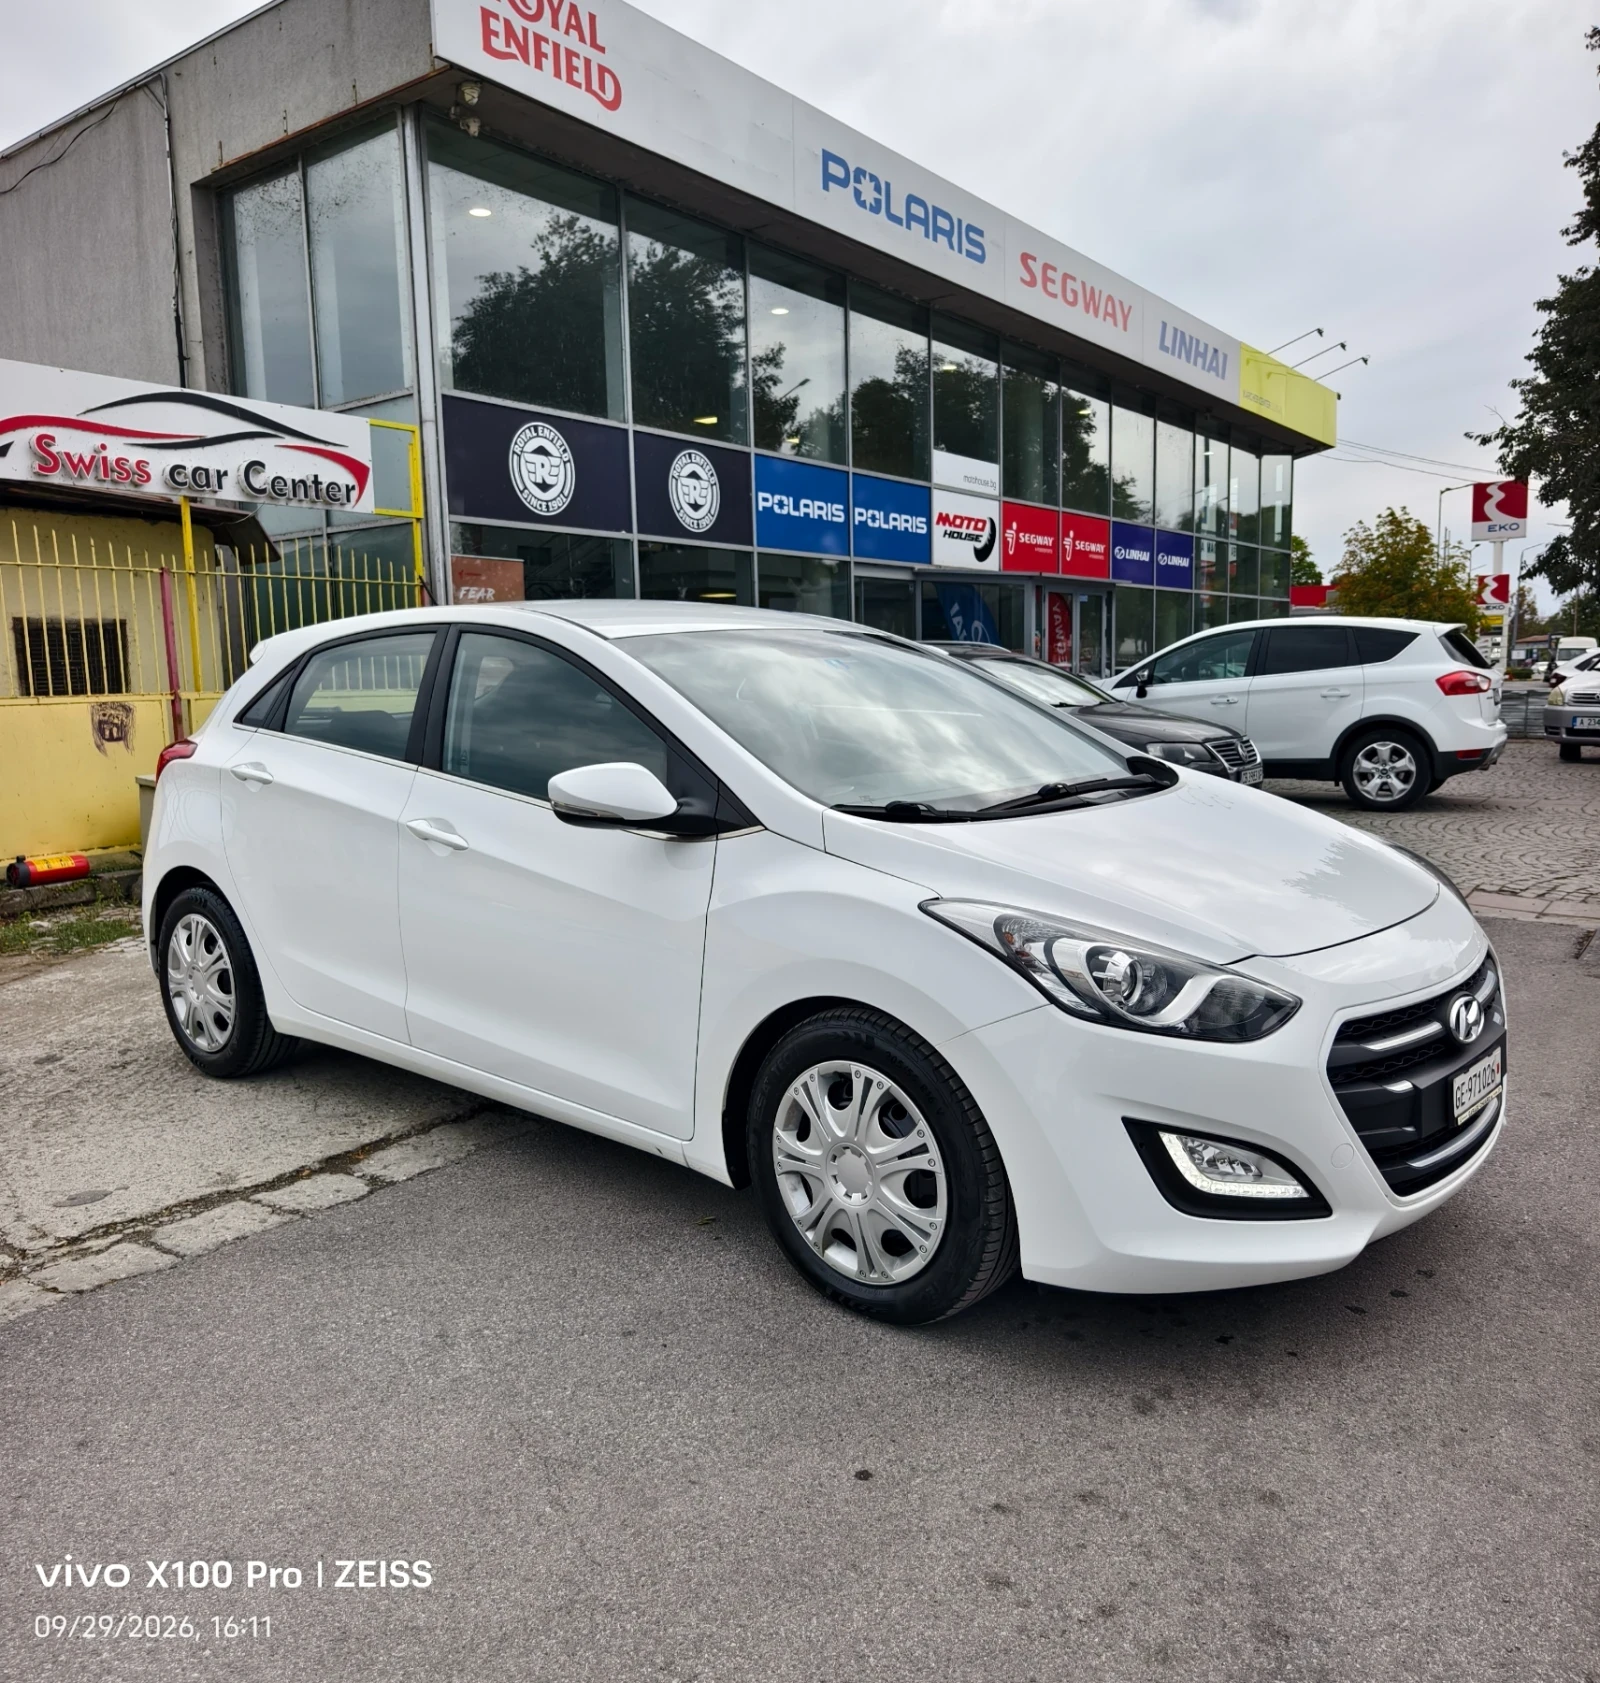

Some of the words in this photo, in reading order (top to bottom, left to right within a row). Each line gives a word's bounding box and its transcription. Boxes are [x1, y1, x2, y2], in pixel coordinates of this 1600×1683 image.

[496, 0, 606, 55] OYAL
[480, 6, 622, 111] ENFIELD
[822, 148, 987, 264] POLARIS
[1019, 251, 1133, 332] SEGWAY
[1158, 320, 1228, 380] LINHAI
[513, 426, 538, 455] ROYAL
[537, 426, 570, 462] ENFIELD
[31, 433, 152, 485] Swiss
[165, 464, 229, 492] car
[238, 460, 357, 505] Center
[522, 489, 548, 511] SINCE
[547, 493, 567, 511] 1901
[757, 492, 845, 523] POLARIS
[855, 507, 927, 534] POLARIS
[936, 511, 987, 532] MOTO
[1487, 522, 1520, 533] EKO
[943, 529, 983, 543] HOUSE
[1019, 532, 1054, 547] SEGWAY
[1075, 540, 1106, 554] SEGWAY
[1125, 548, 1150, 562] LINHAI
[1167, 555, 1190, 567] LINHAI
[459, 586, 496, 600] FEAR
